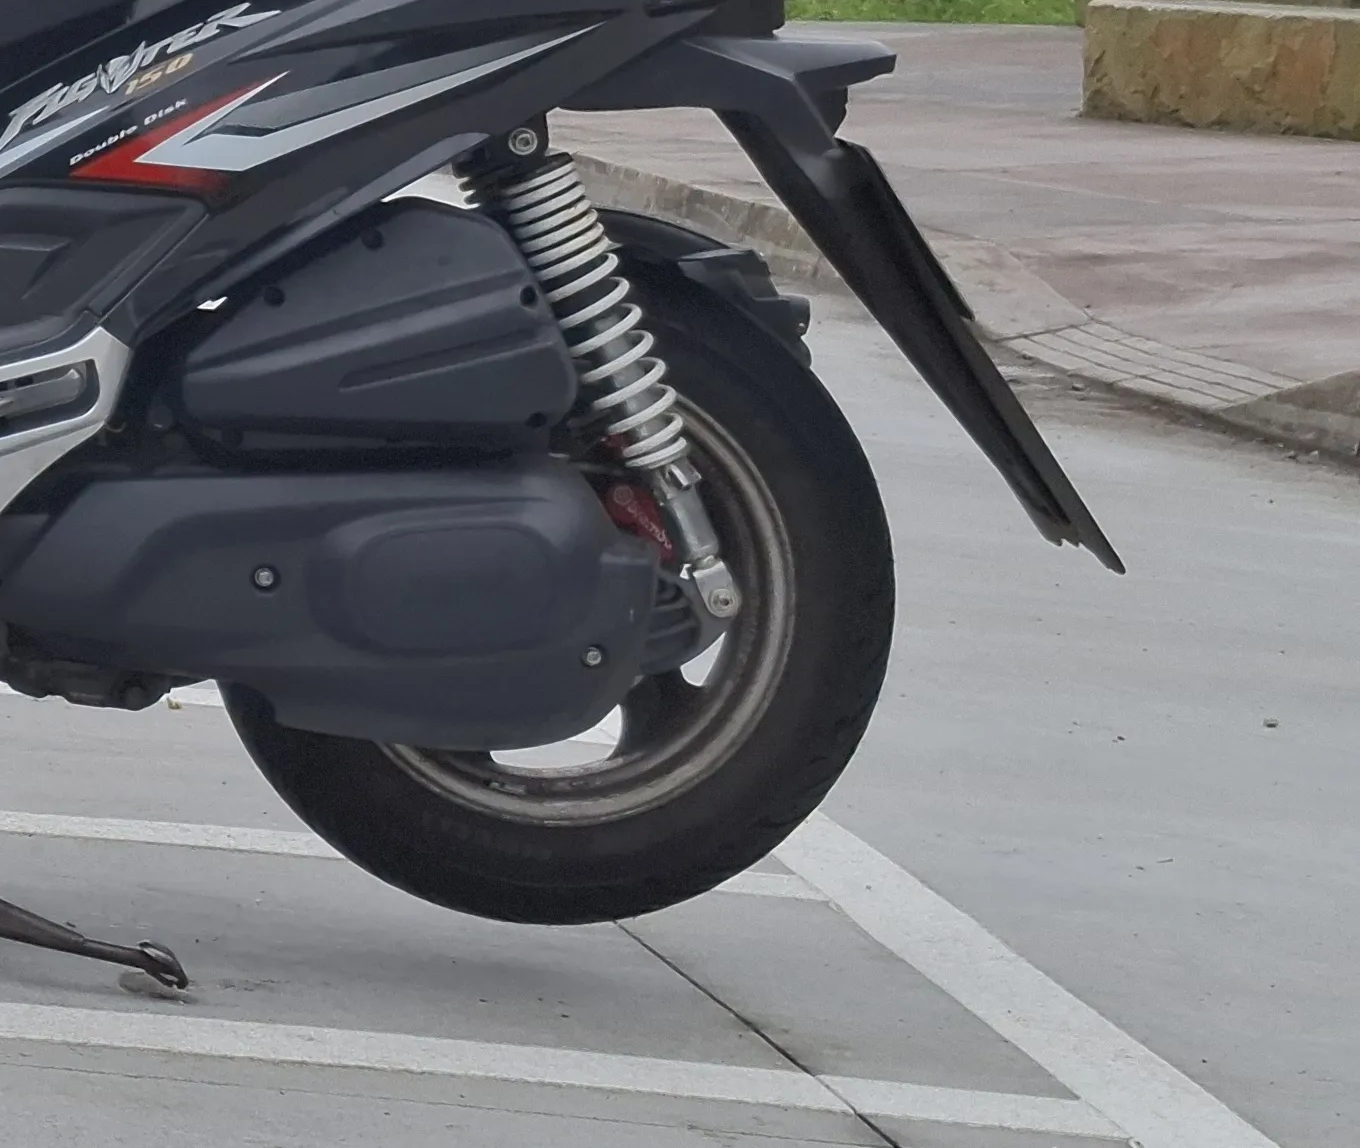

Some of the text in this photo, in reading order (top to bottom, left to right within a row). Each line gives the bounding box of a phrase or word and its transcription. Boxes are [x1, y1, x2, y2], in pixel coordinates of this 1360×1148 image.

[124, 52, 194, 96] 150
[69, 99, 188, 166] Double Disk
